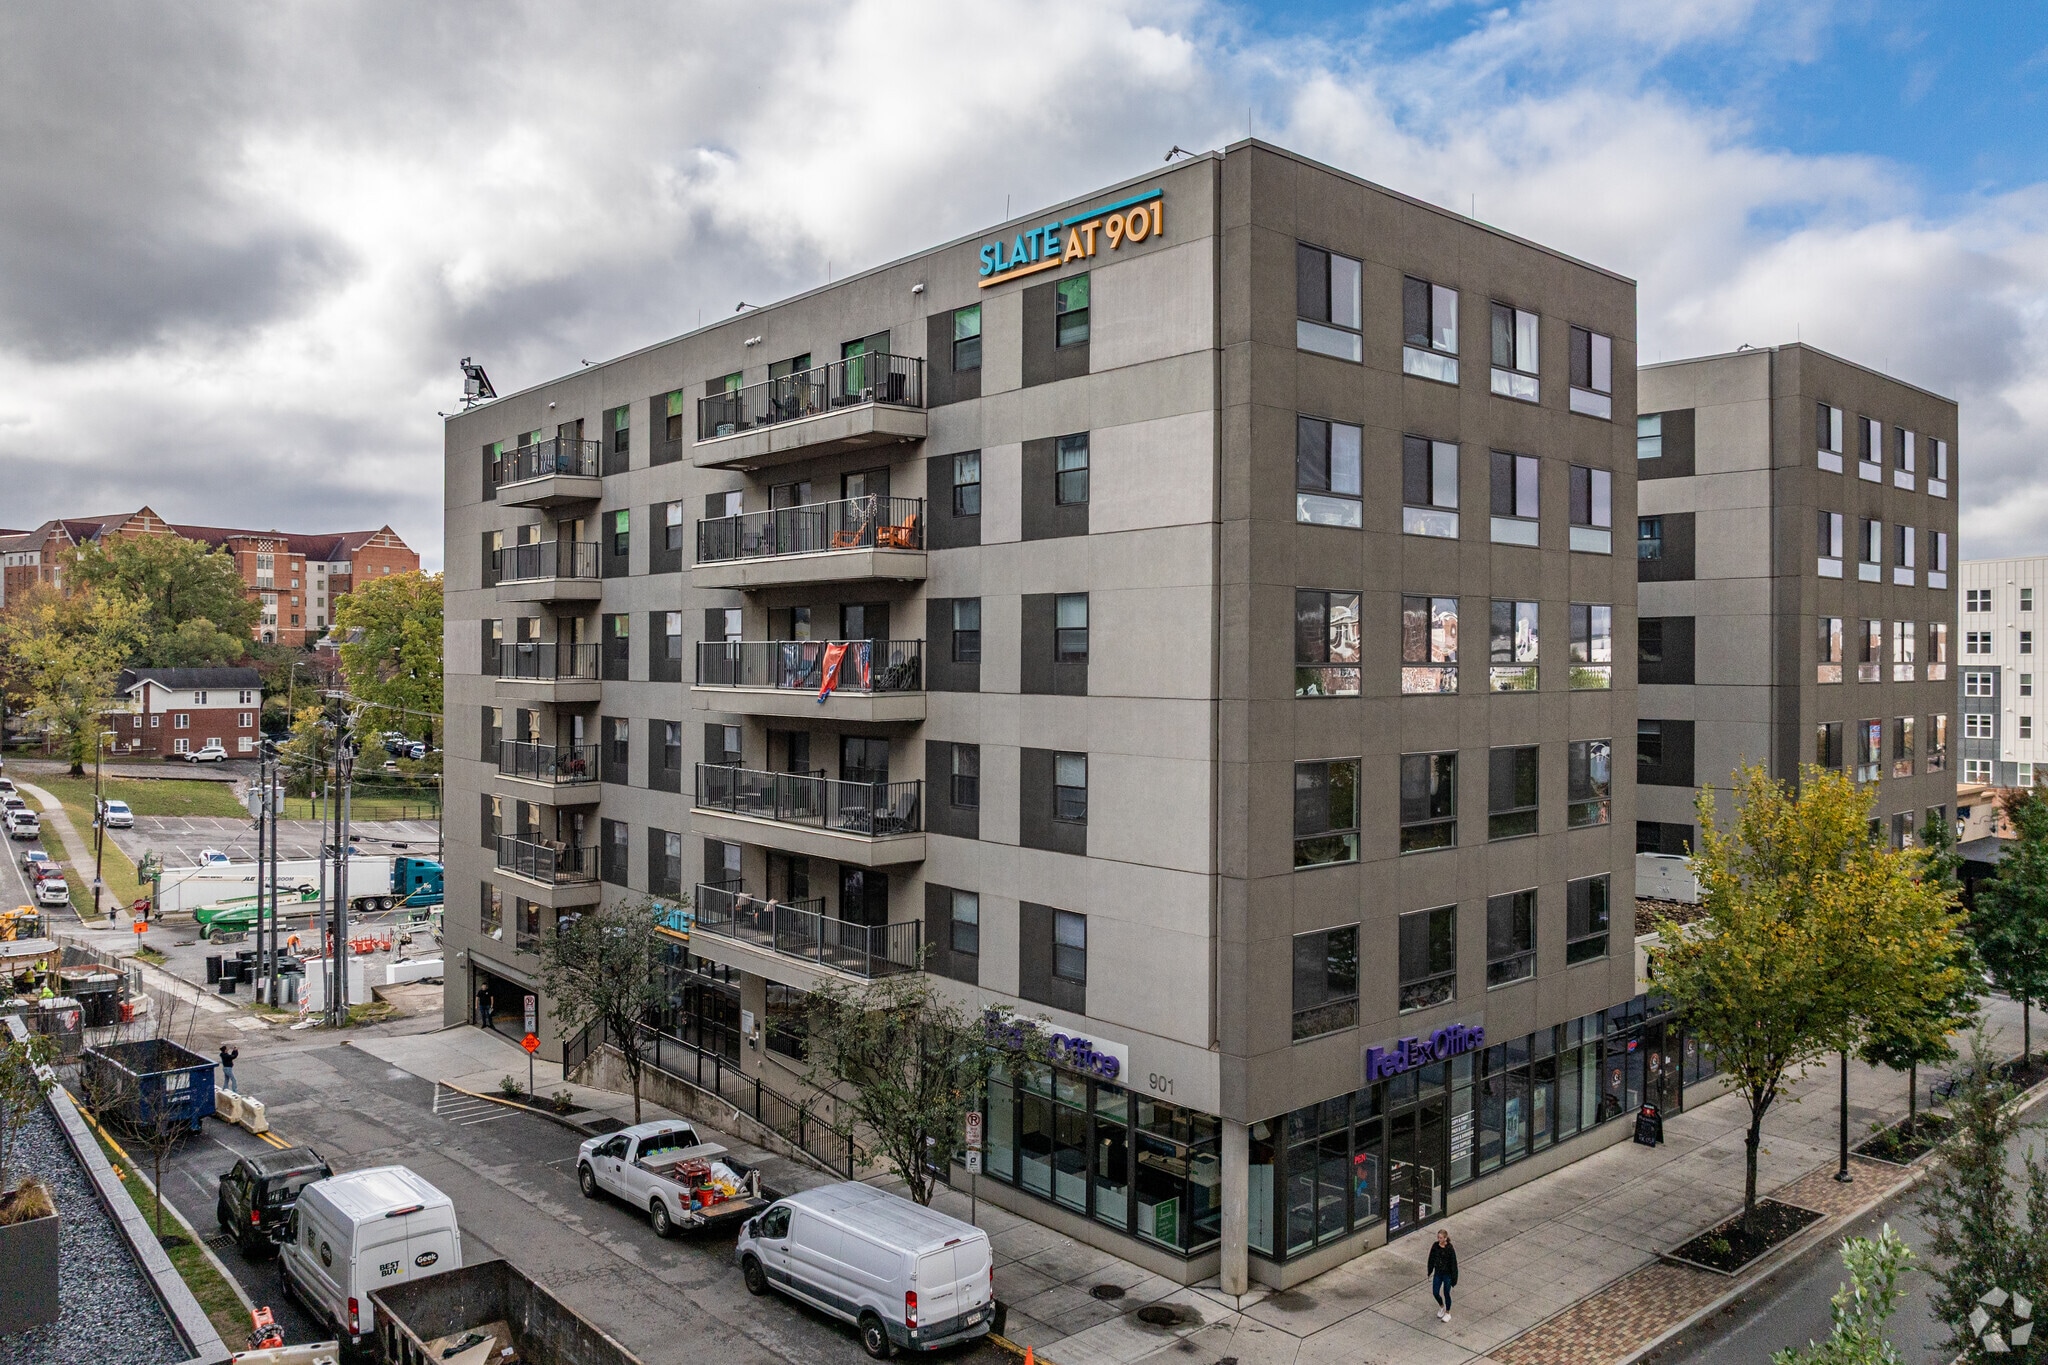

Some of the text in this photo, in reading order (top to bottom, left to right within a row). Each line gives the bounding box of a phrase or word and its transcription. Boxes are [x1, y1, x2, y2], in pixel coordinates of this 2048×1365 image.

[979, 200, 1164, 277] SLATE AT 901
[1050, 1032, 1121, 1079] Office
[1149, 1072, 1175, 1097] 901
[1353, 1152, 1367, 1166] PEN
[380, 1260, 400, 1271] BEST
[417, 1253, 437, 1264] Geek
[381, 1267, 398, 1277] BUY
